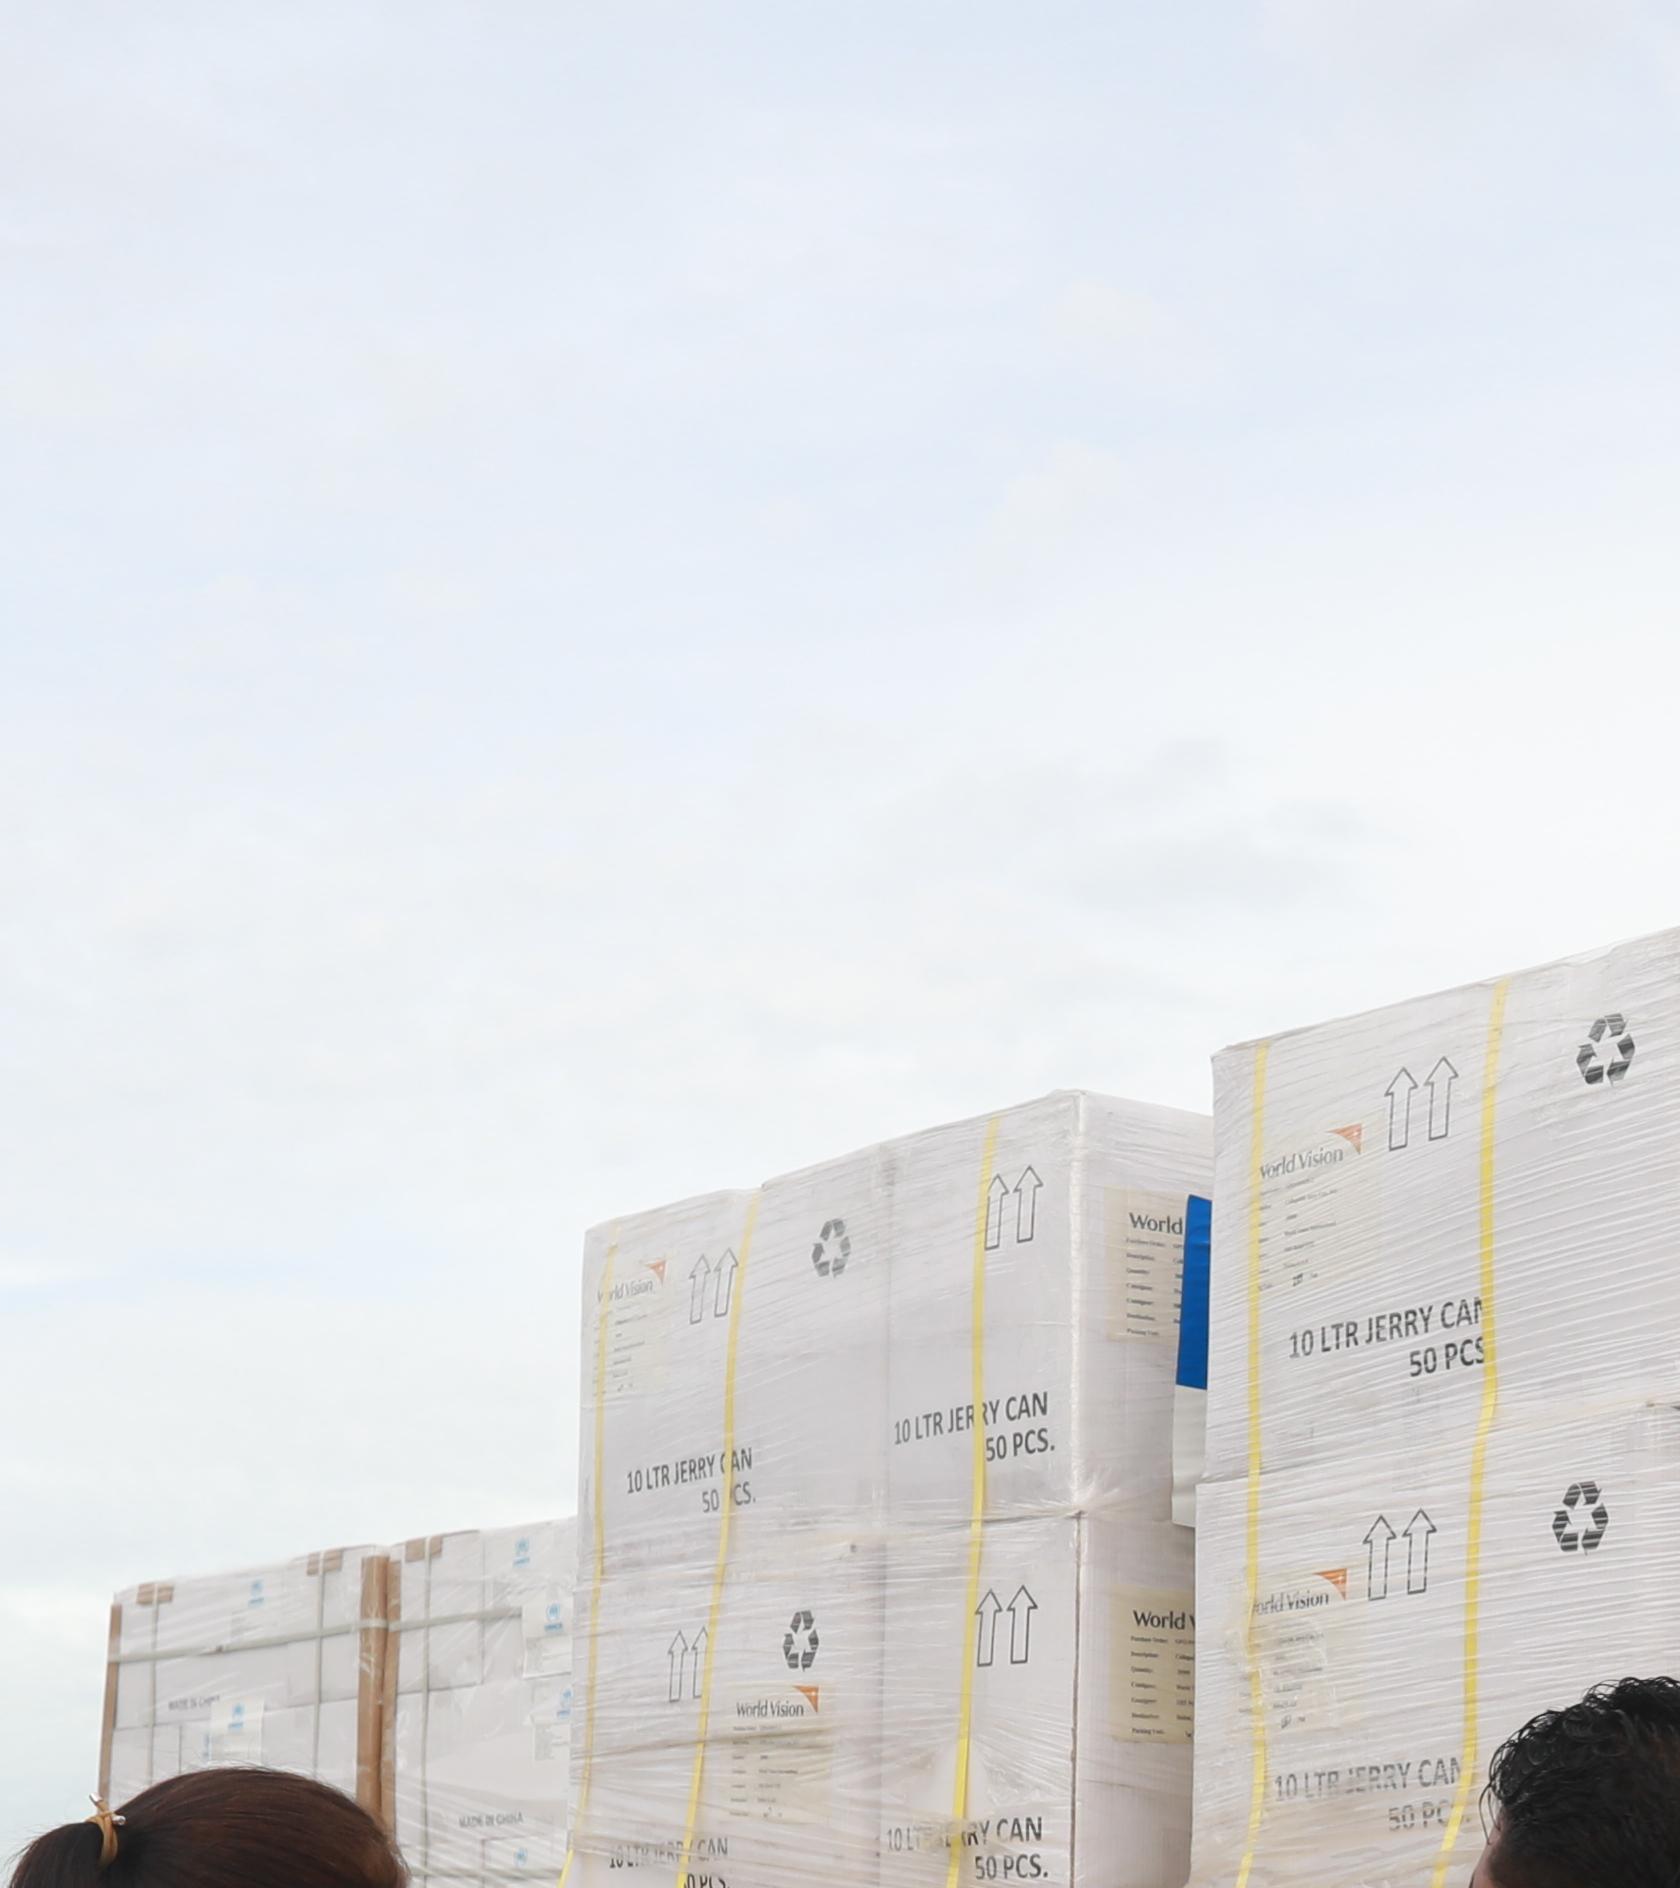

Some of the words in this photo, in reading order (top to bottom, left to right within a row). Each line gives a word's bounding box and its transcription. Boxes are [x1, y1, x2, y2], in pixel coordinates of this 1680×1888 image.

[1128, 1211, 1184, 1236] World
[1288, 1329, 1315, 1358] 10
[1320, 1321, 1360, 1353] LTR
[1365, 1304, 1434, 1346] JERRY
[985, 1434, 1007, 1463] 50
[1011, 1426, 1056, 1458] PCS.
[626, 1470, 643, 1494] 10
[646, 1465, 670, 1491] LTR
[674, 1456, 716, 1488] JERRY
[1132, 1609, 1186, 1631] World
[735, 1699, 767, 1720] World
[769, 1697, 805, 1719] Vision
[997, 1814, 1044, 1845] CAN
[1388, 1804, 1415, 1831] 50
[974, 1855, 997, 1882] 50
[1002, 1851, 1049, 1881] PCS.
